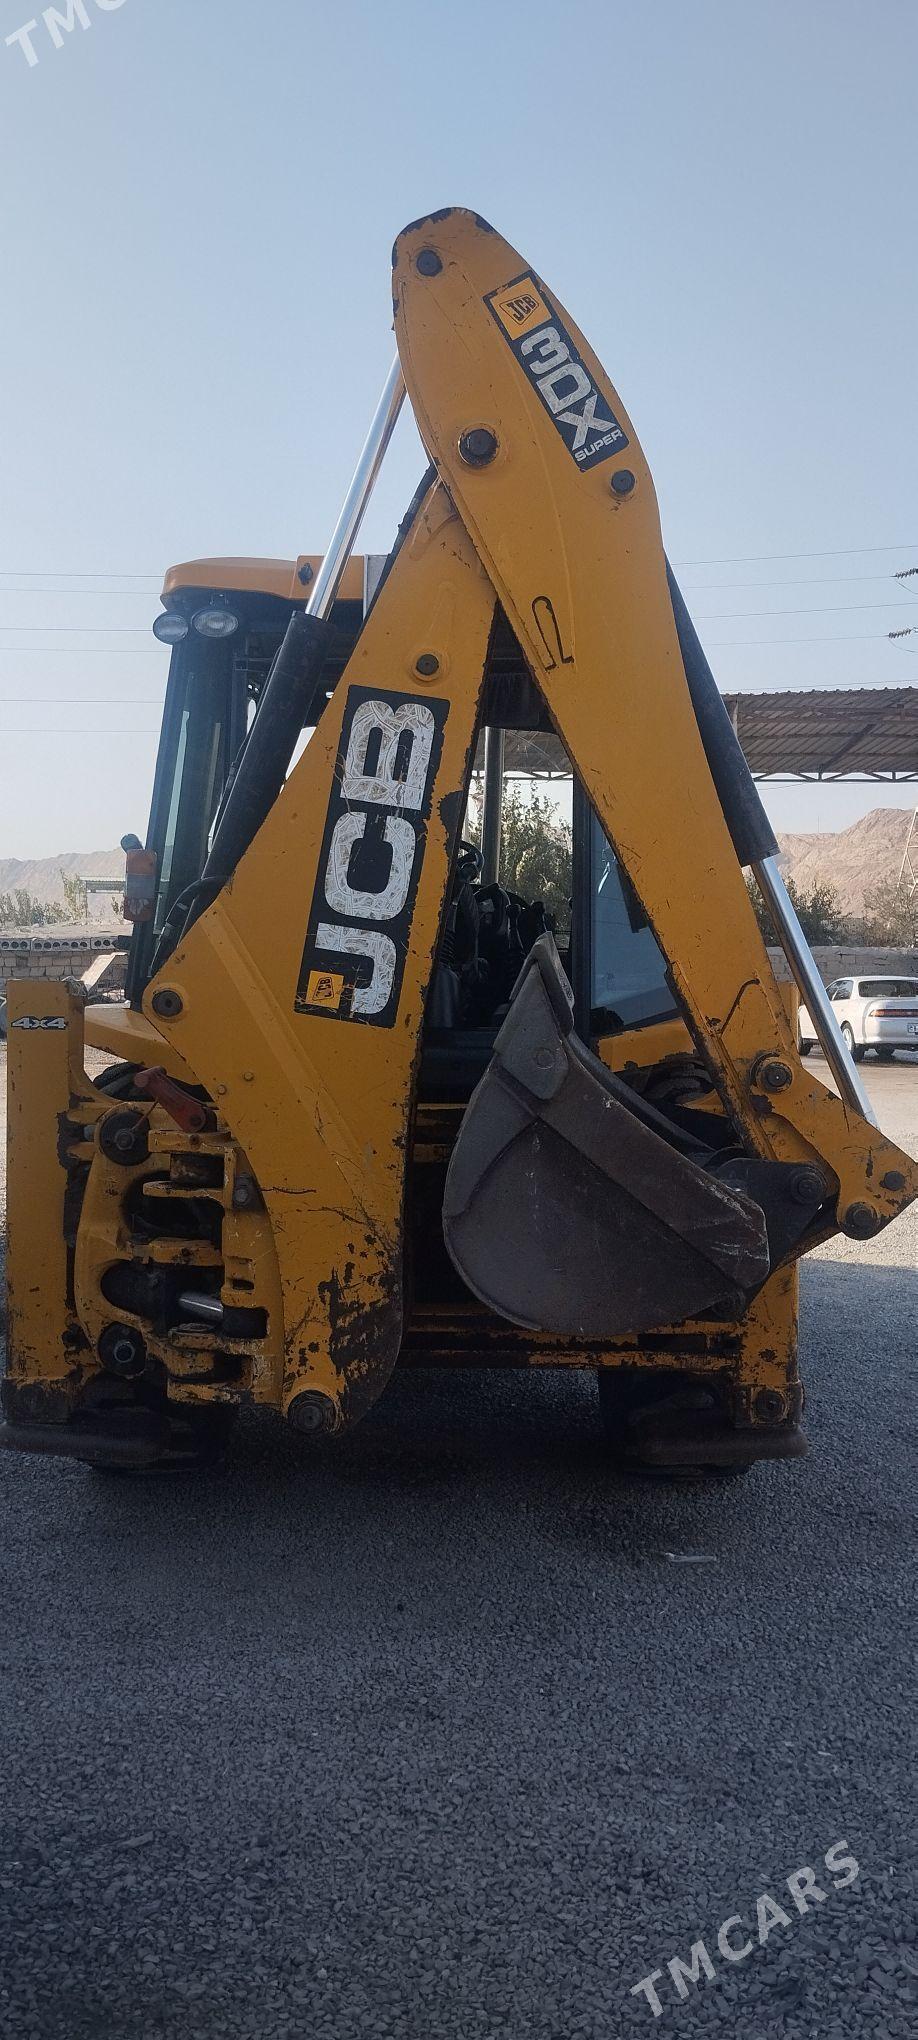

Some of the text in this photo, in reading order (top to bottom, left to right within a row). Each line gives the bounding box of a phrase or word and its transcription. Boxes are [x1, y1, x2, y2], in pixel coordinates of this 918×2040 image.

[505, 294, 538, 321] JCB
[520, 326, 618, 451] 3DX
[574, 428, 623, 462] SUPER
[314, 700, 435, 1015] JCB
